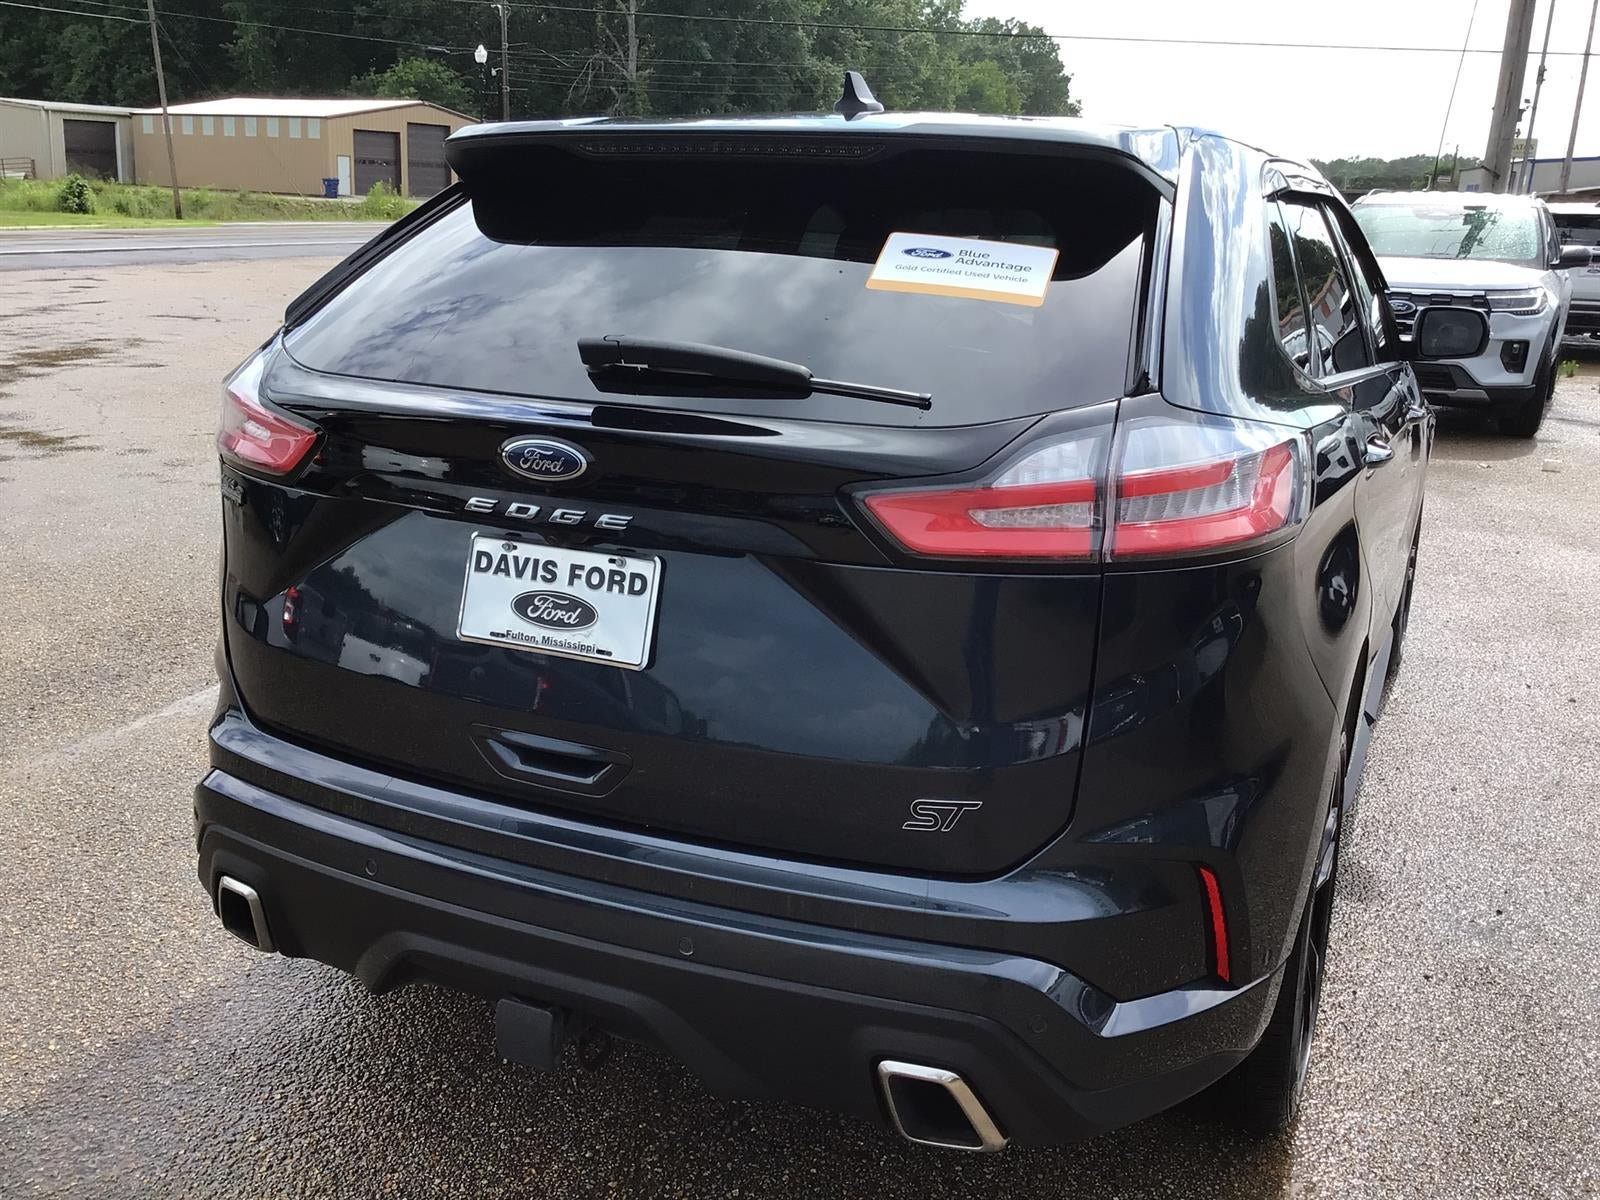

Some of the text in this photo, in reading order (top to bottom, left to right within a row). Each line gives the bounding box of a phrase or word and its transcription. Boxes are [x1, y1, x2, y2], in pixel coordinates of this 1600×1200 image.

[955, 257, 1032, 273] Advantage
[959, 249, 990, 259] Blue
[920, 266, 962, 276] Certified
[964, 271, 990, 279] Used
[993, 274, 1029, 283] Vehicle
[519, 447, 565, 473] Ford
[464, 496, 633, 530] EDGE
[474, 550, 648, 596] DAVIS FORD
[526, 595, 580, 625] Ford
[505, 630, 596, 653] Fulton, Mississippi
[902, 799, 983, 832] ST
